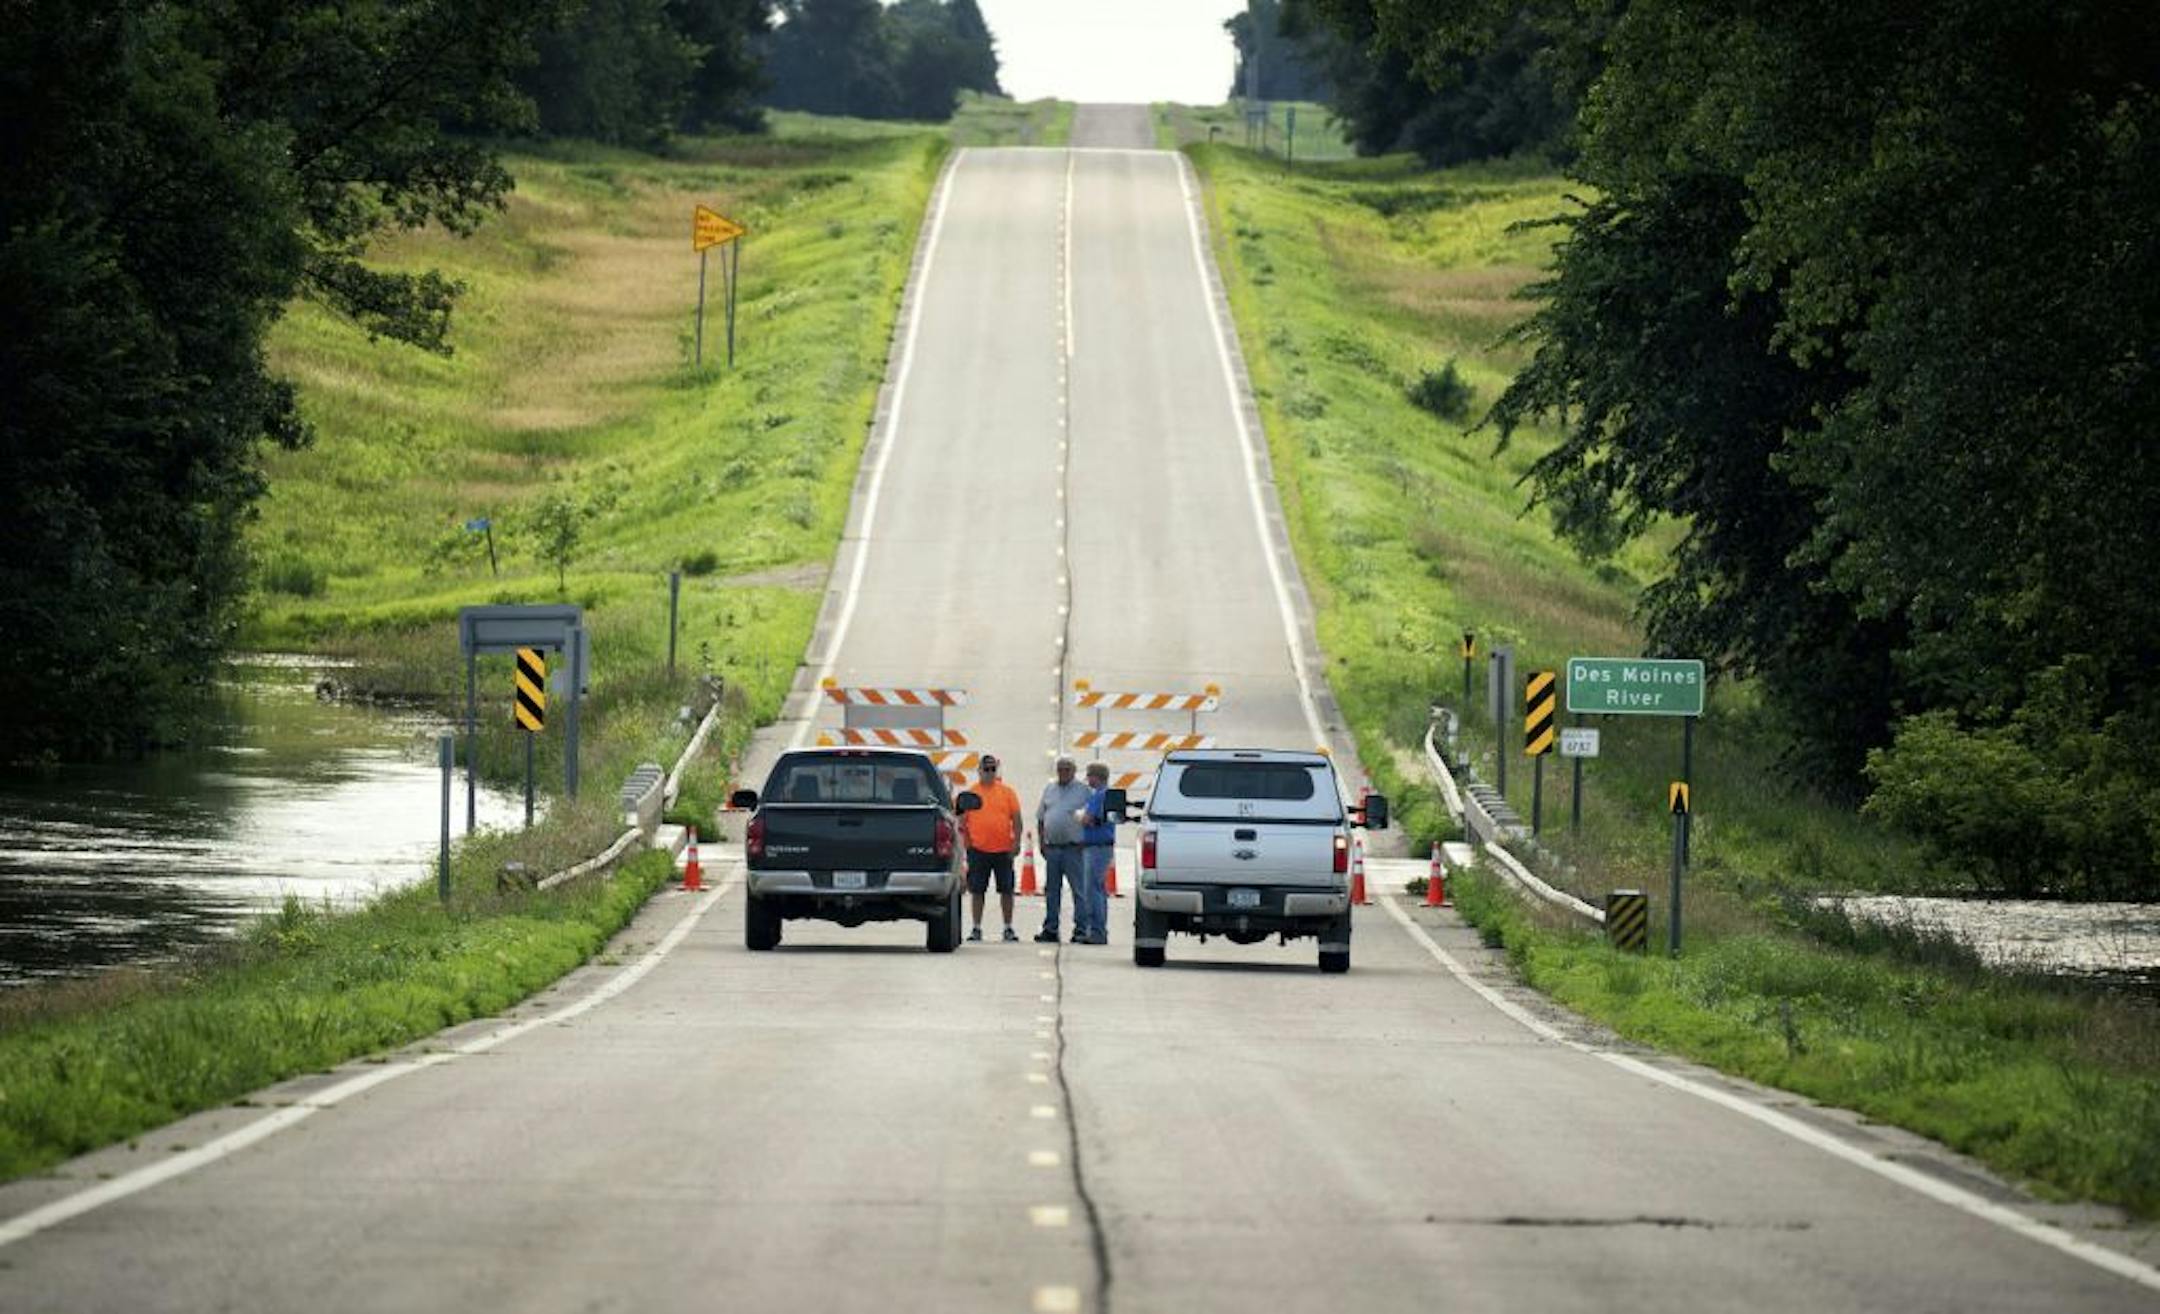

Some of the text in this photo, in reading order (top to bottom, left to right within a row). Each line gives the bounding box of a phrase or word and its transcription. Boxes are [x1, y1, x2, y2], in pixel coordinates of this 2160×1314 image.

[1574, 665, 1697, 684] Des Moines
[1606, 689, 1662, 705] River
